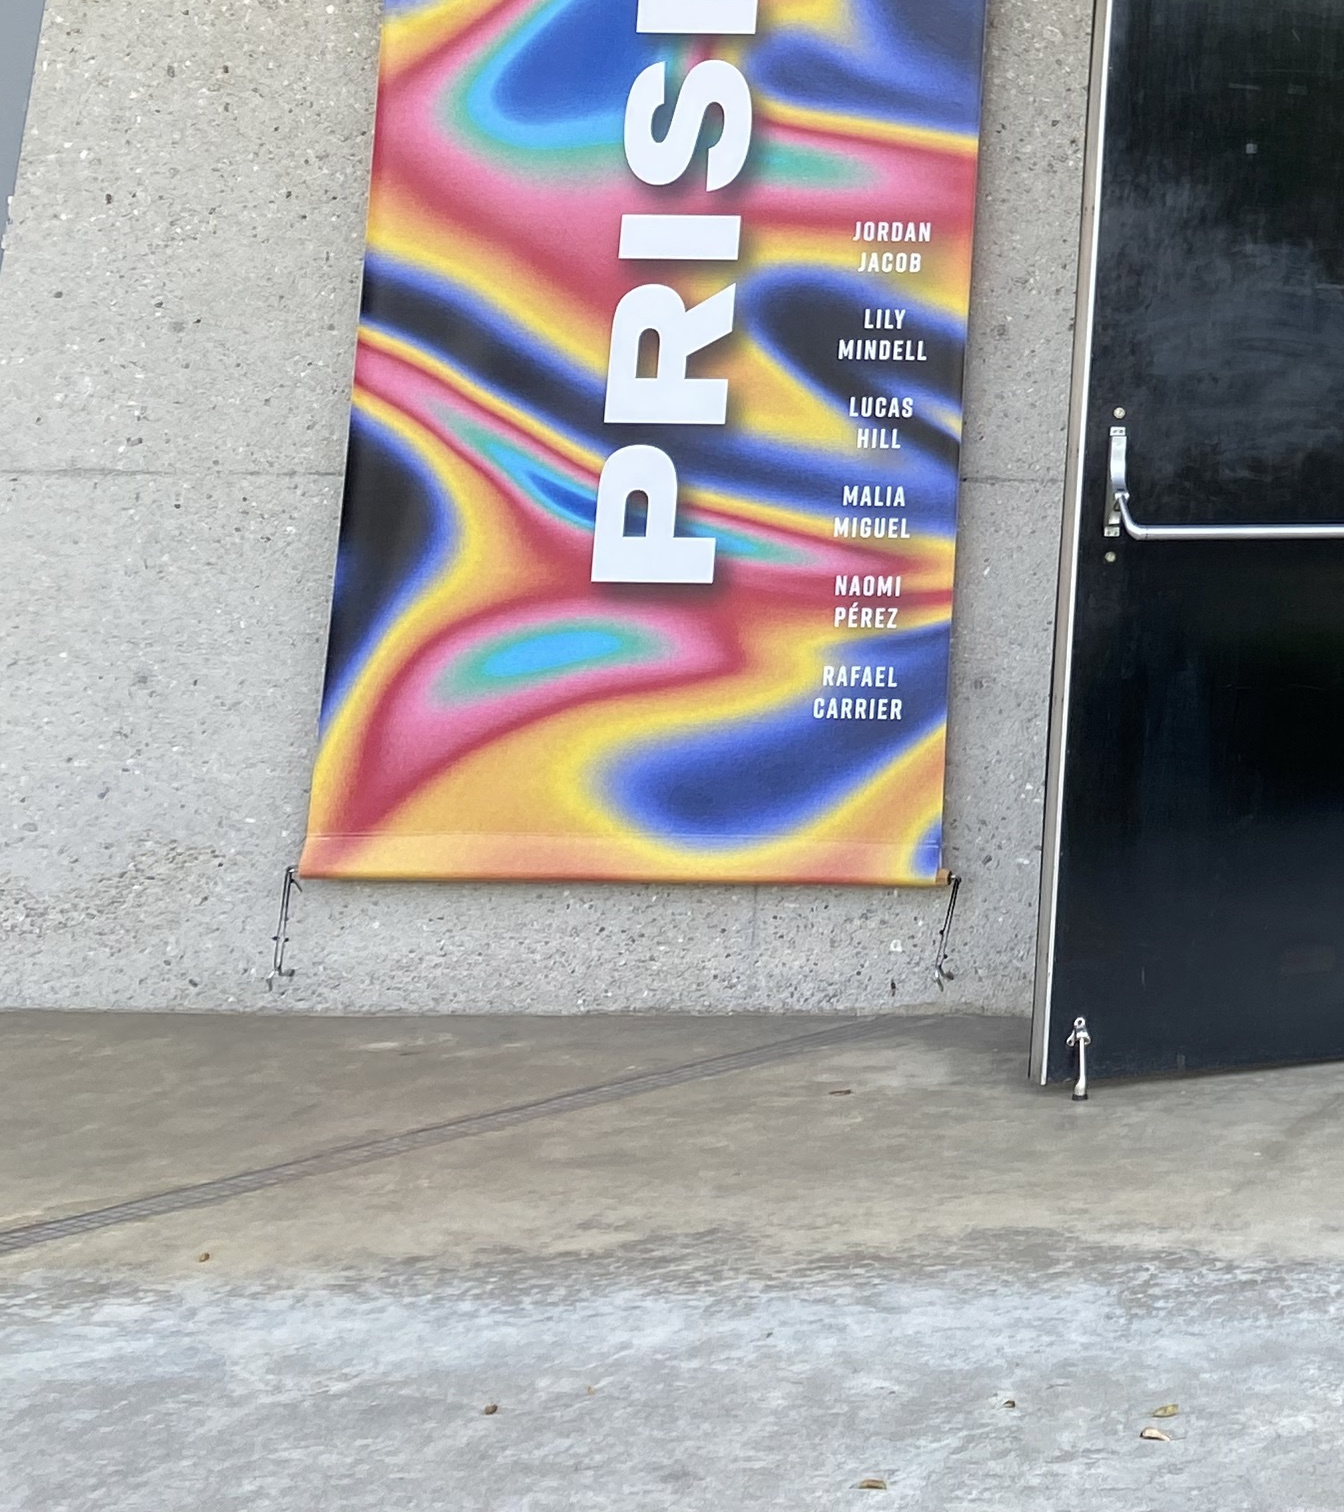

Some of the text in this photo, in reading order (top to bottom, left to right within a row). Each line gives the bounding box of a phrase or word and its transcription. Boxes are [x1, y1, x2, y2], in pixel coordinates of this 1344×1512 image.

[853, 222, 931, 242] JORDAN
[858, 253, 922, 273] JACOB
[864, 309, 906, 329] LILY
[838, 340, 927, 361] MINDELL
[849, 397, 913, 418] LUCAS
[857, 428, 901, 449] HILL
[843, 486, 905, 507] MALIA
[833, 517, 910, 539] MIGUEL
[835, 576, 900, 597] NAOMI
[834, 602, 899, 629] PÉREZ
[822, 666, 897, 688] RAFAEL
[813, 698, 902, 720] CARRIER
